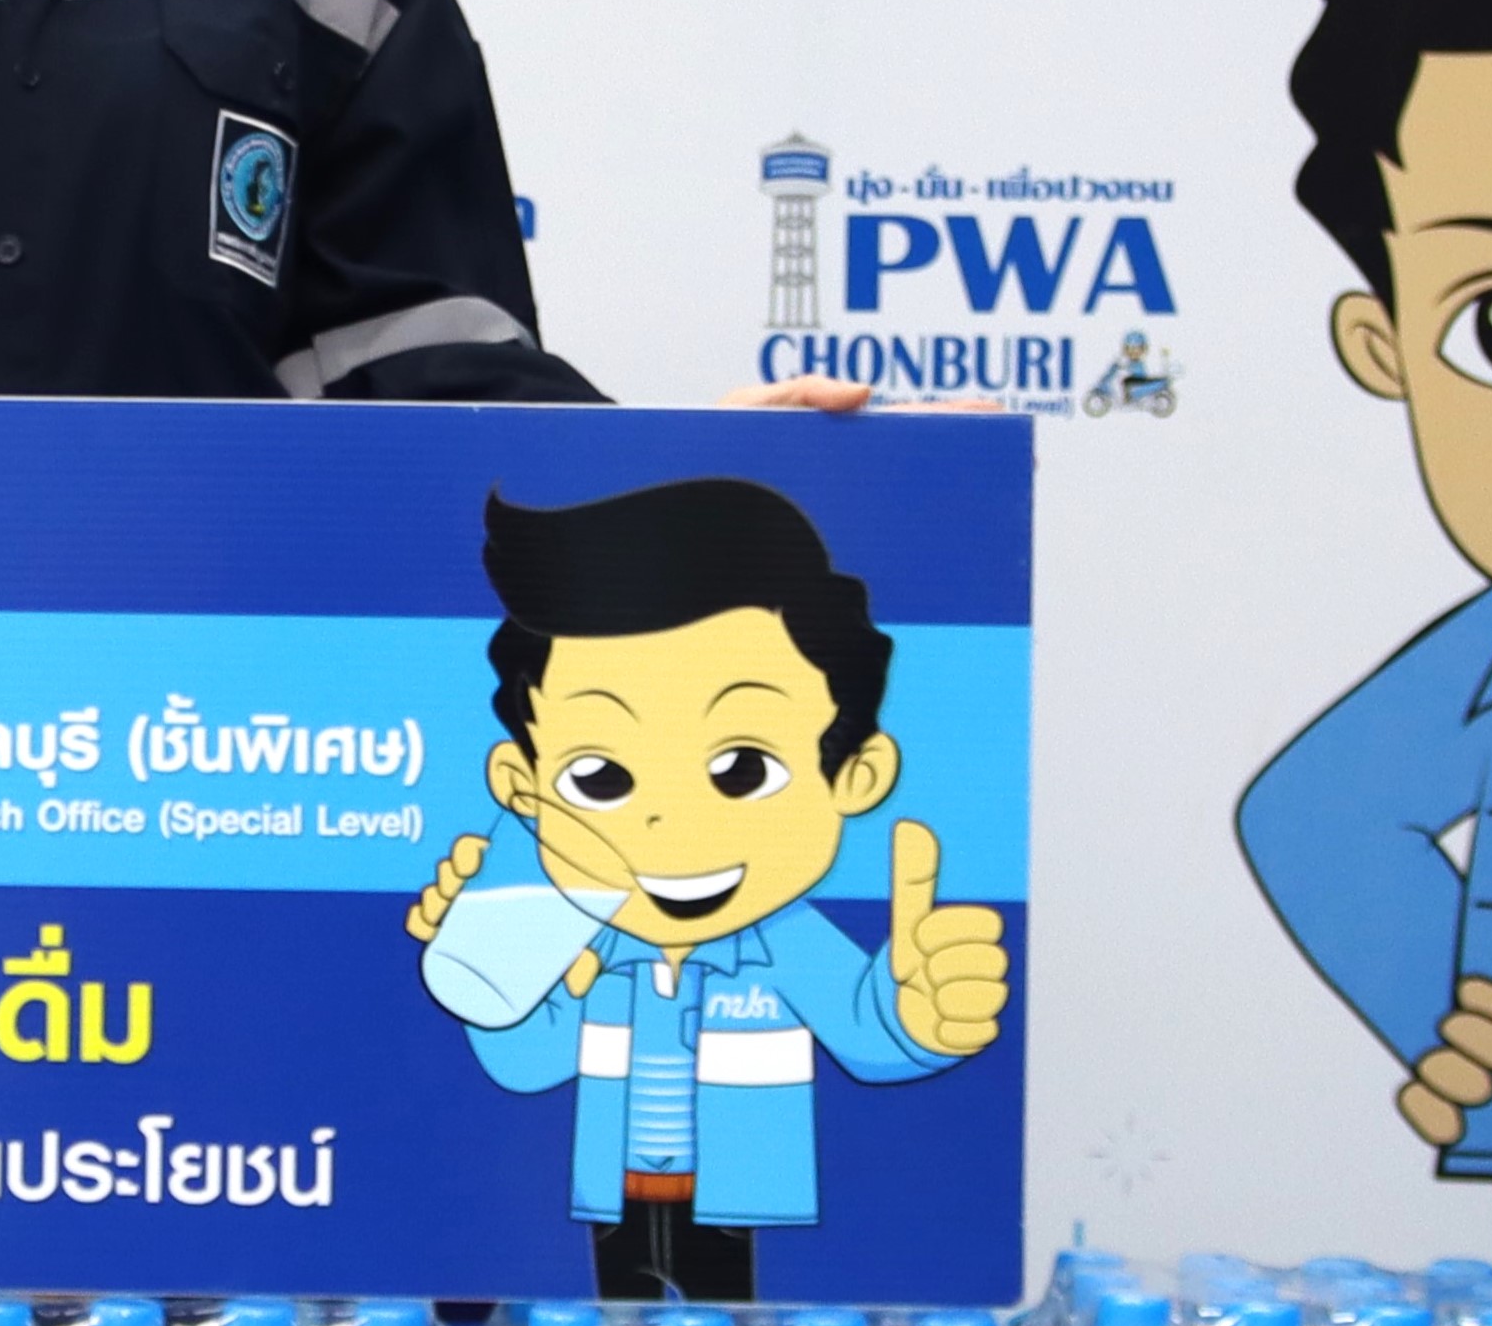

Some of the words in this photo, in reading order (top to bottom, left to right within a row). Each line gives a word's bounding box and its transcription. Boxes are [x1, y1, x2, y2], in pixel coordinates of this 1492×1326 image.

[845, 215, 1178, 315] PWA
[760, 333, 1073, 391] CHONBURI
[129, 694, 423, 789] (ชั้นพิเศษ)
[37, 800, 143, 834] Office
[159, 801, 304, 842] (Special
[316, 802, 423, 842] Level)
